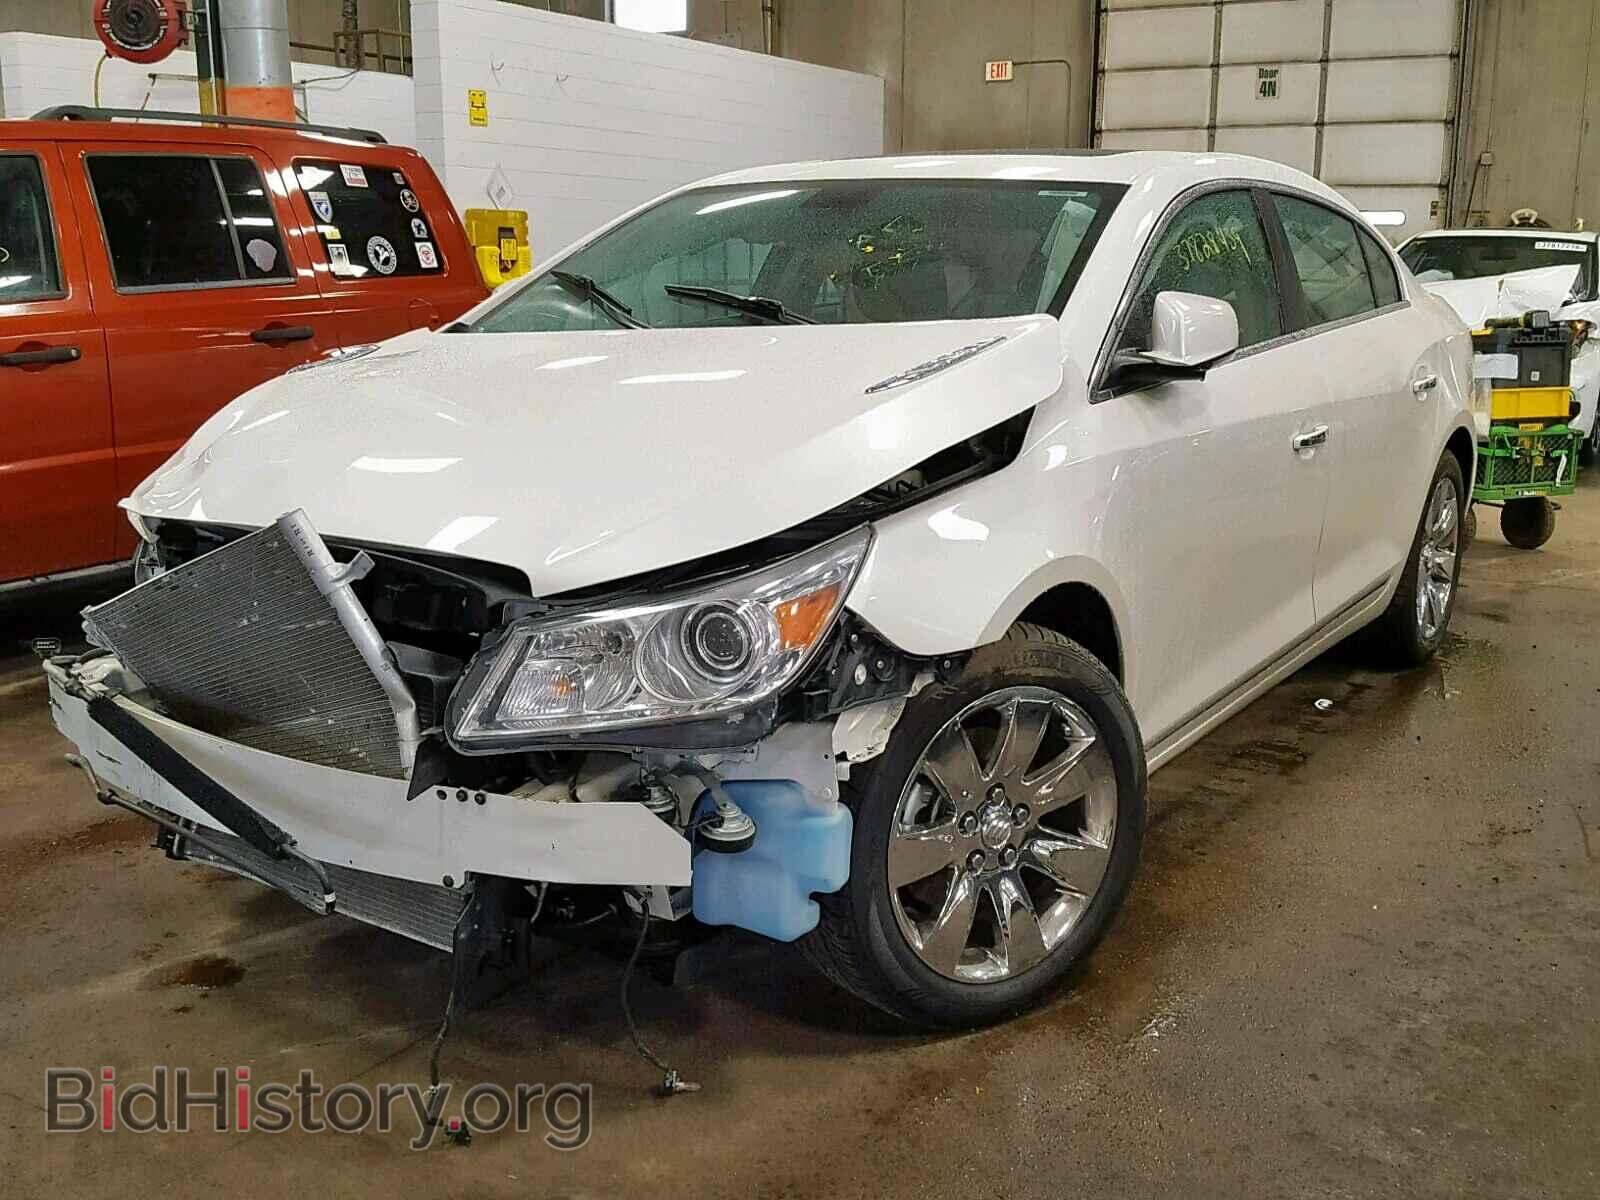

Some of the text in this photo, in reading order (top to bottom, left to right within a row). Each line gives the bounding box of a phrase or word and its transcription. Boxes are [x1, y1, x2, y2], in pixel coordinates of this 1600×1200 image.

[991, 63, 1009, 78] EXIT
[1258, 68, 1279, 79] Door
[1259, 81, 1277, 97] 4N
